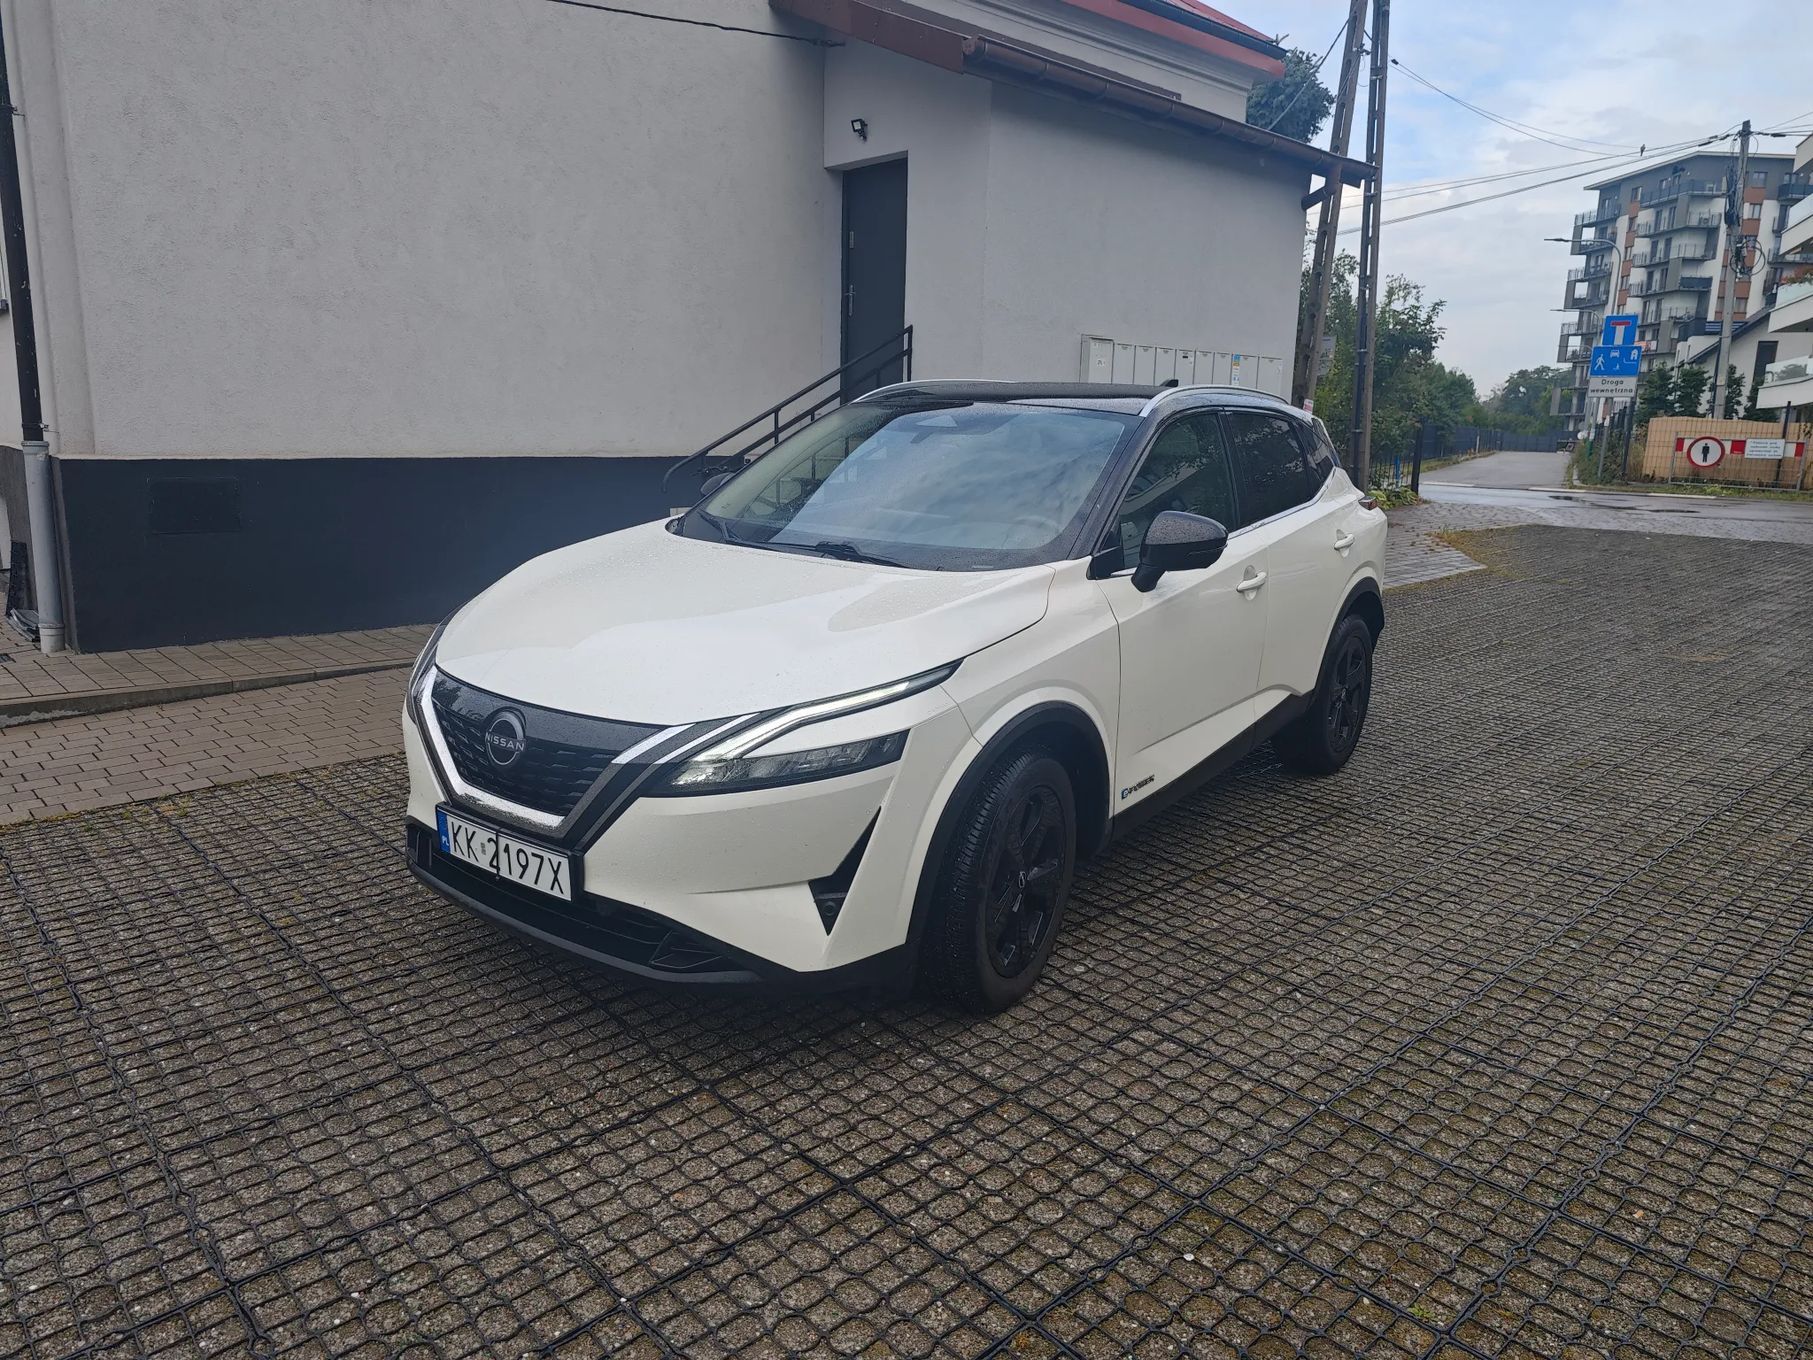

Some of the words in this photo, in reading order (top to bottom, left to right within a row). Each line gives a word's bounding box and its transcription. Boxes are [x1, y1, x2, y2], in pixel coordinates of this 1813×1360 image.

[1601, 378, 1624, 386] Droga
[1590, 387, 1633, 395] wewnętrzna
[485, 731, 525, 752] NISSAN
[442, 835, 449, 847] PL
[451, 821, 479, 862] KK
[487, 837, 564, 895] 2197X
